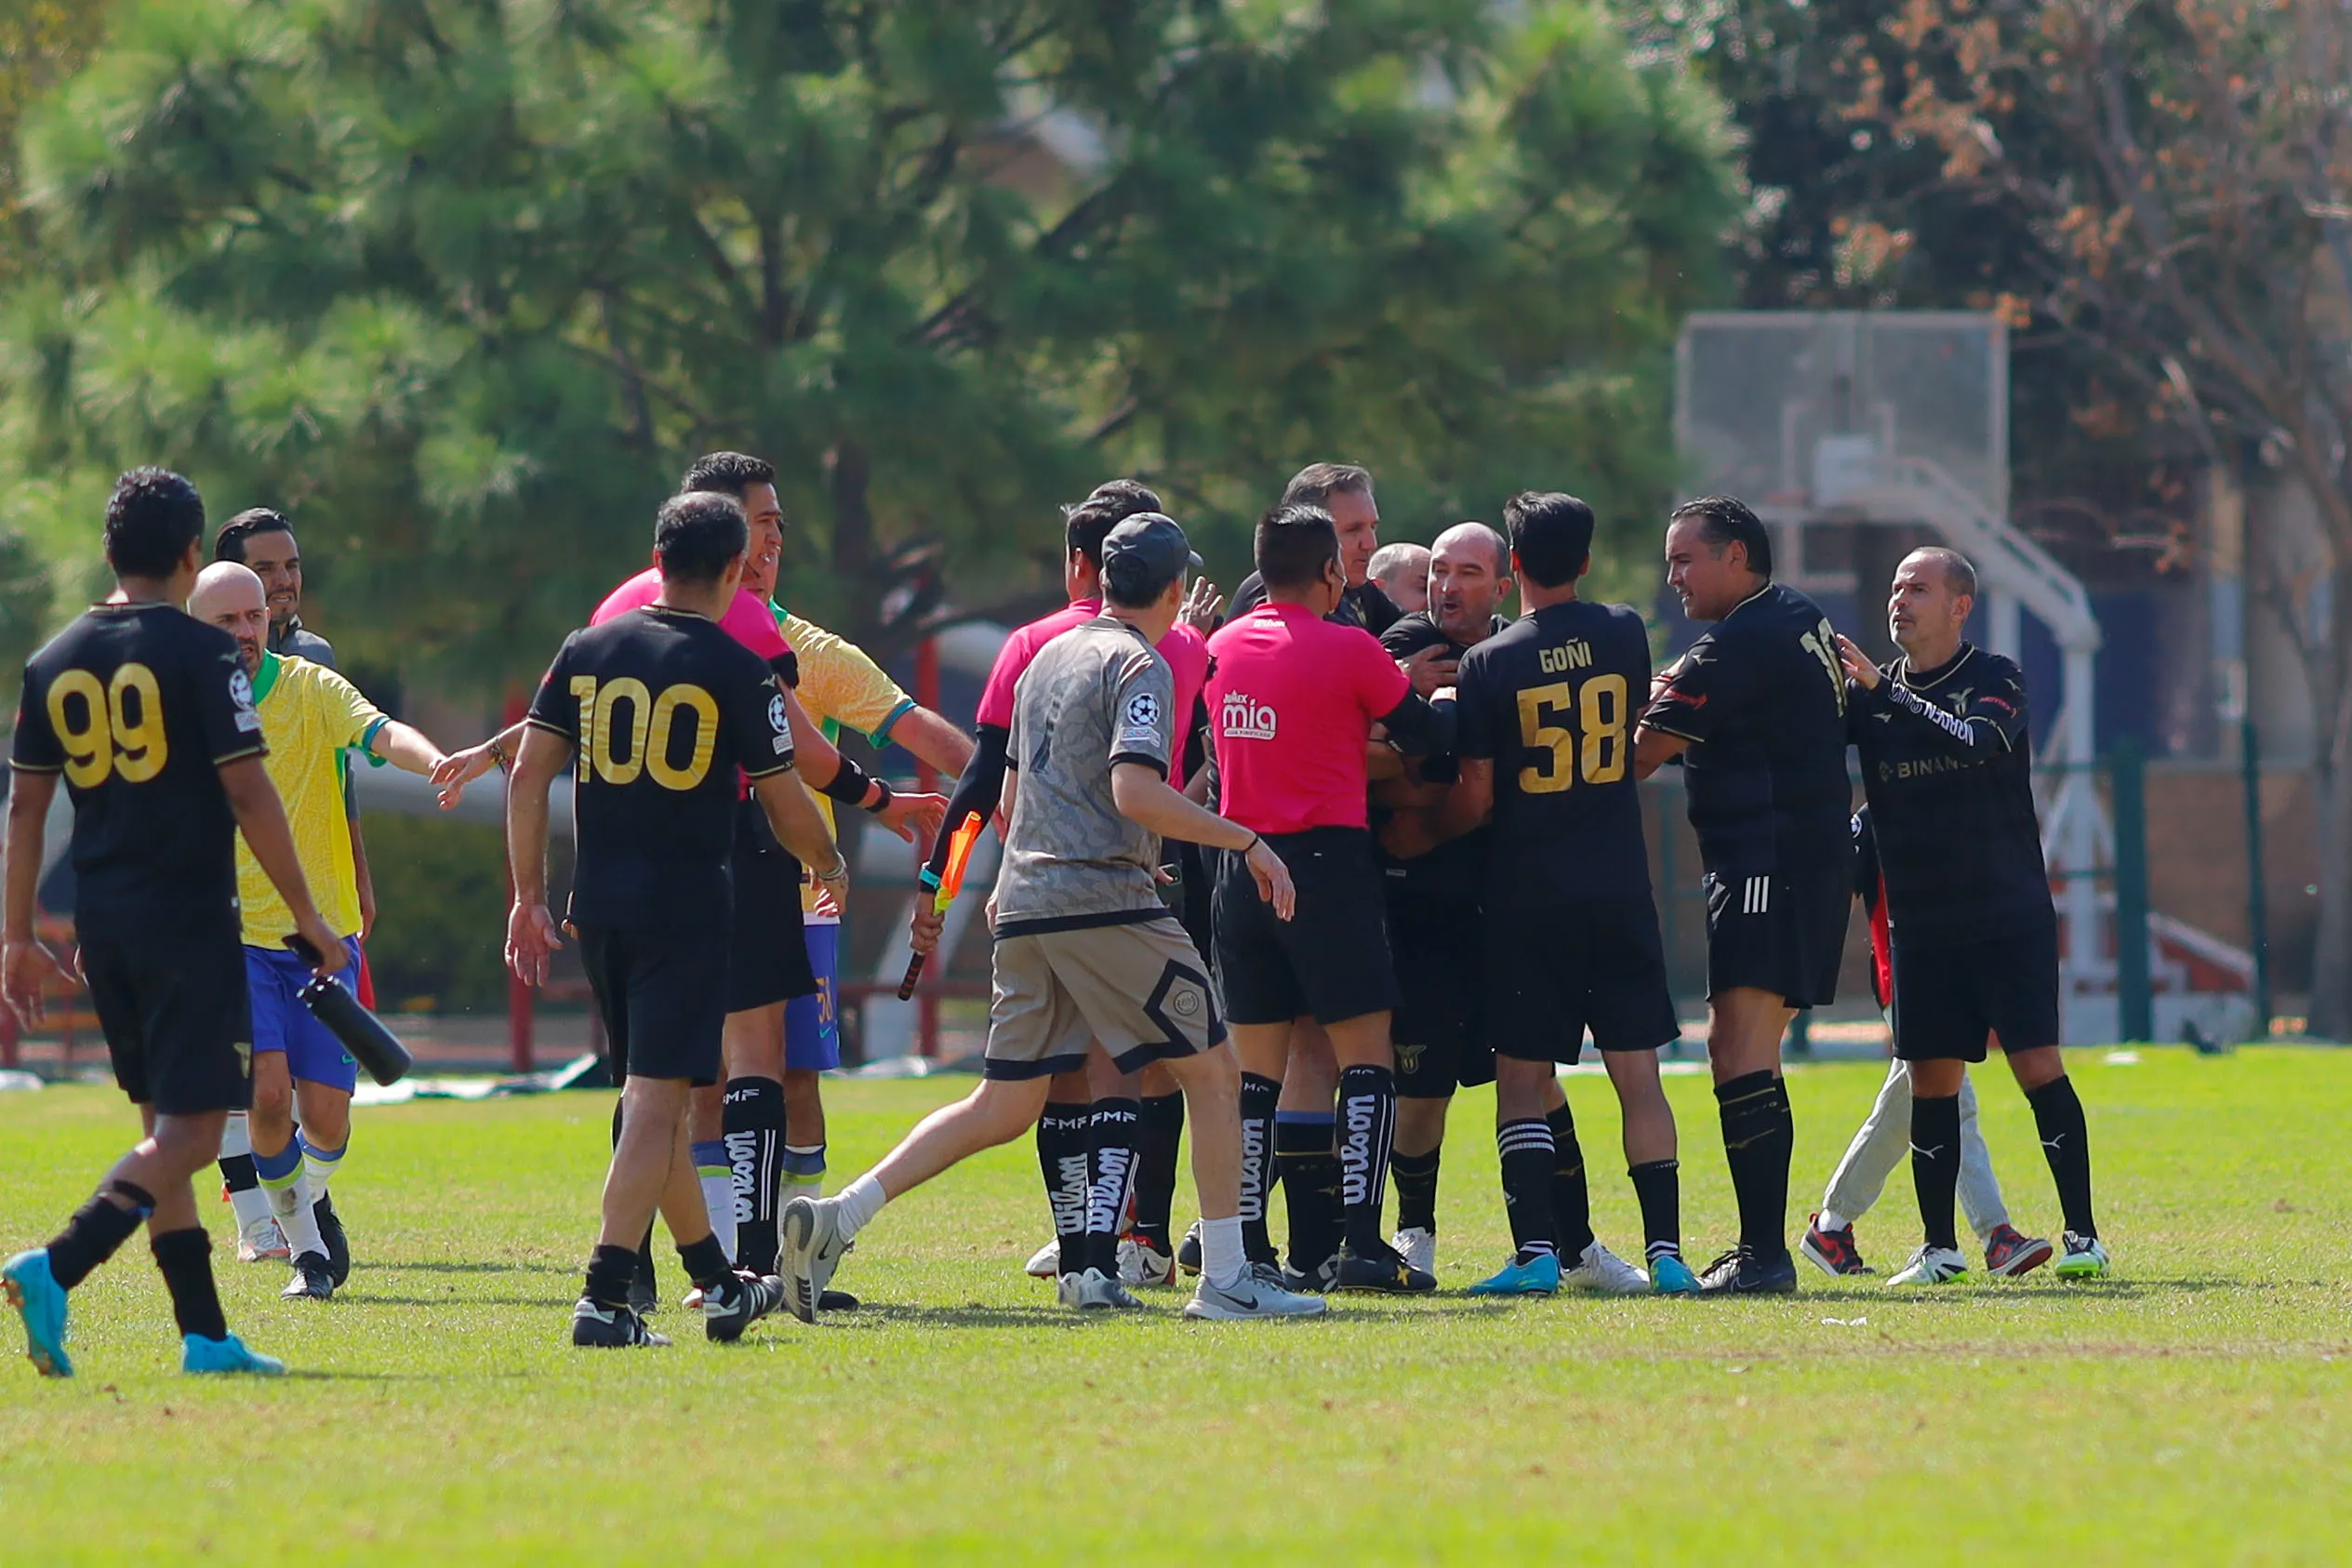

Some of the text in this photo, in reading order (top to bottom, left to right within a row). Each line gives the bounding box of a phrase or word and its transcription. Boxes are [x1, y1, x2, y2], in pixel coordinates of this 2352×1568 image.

[1538, 636, 1593, 674] GOÑI
[47, 662, 169, 790] 99
[569, 674, 720, 791] 100
[1517, 672, 1628, 793] 58
[1043, 1115, 1087, 1130] FMF
[1090, 1110, 1136, 1127] FMF
[1050, 1152, 1088, 1237] Wilson
[1086, 1147, 1130, 1237] Wilson
